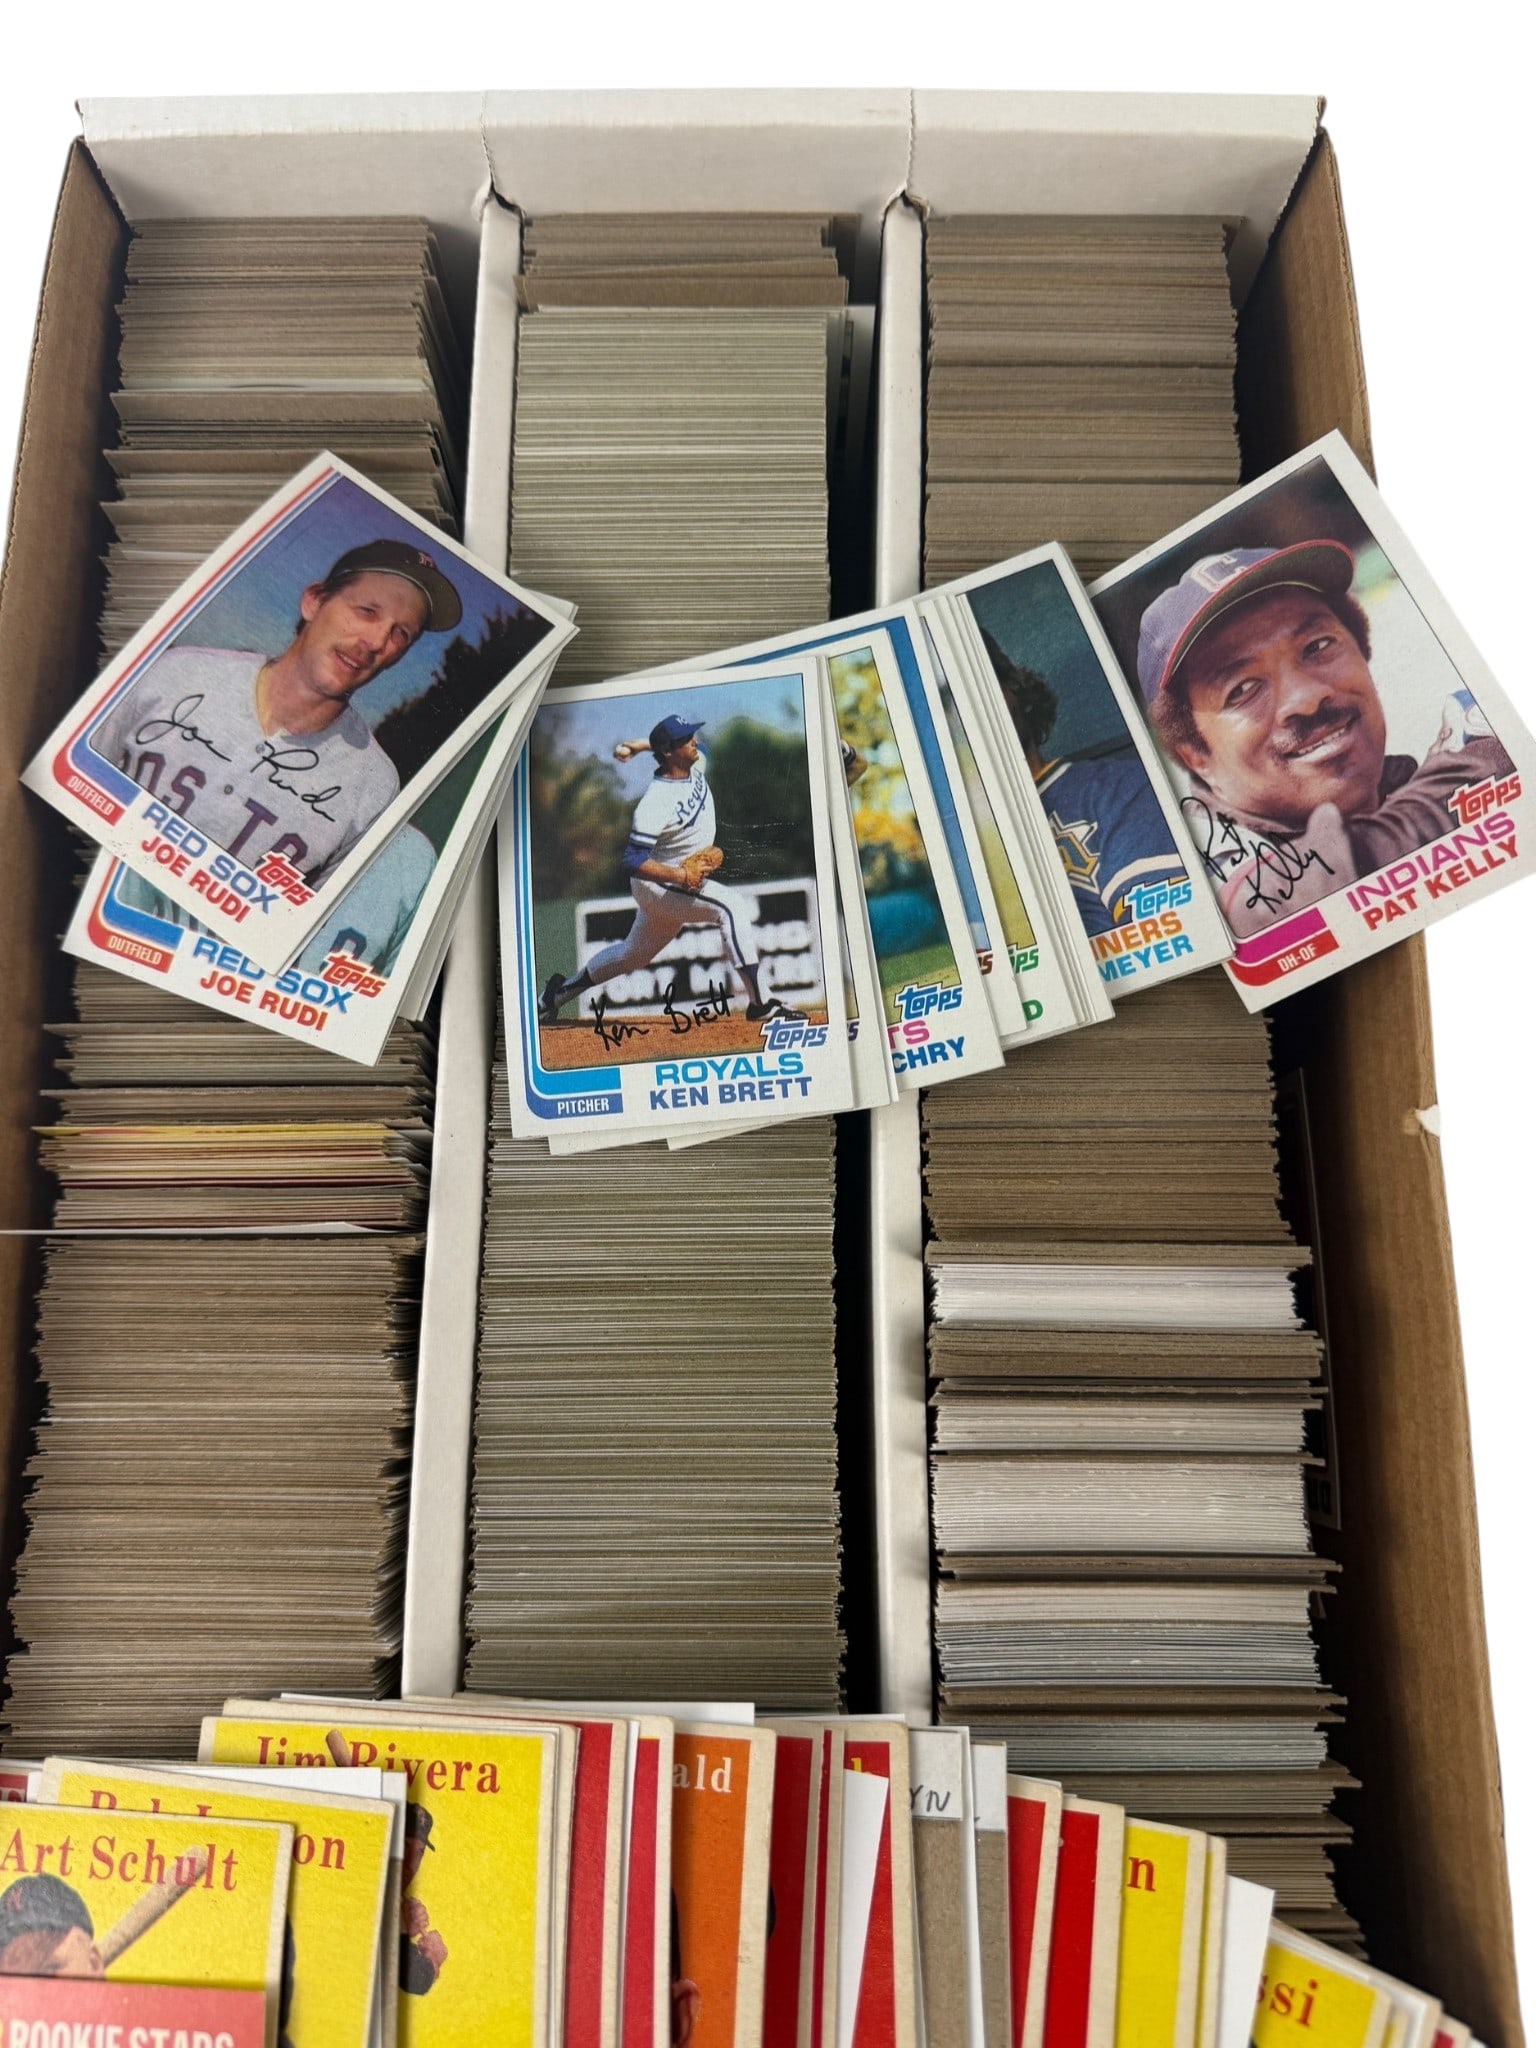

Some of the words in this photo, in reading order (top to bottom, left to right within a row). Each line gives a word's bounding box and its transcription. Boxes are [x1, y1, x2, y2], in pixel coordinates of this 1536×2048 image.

[67, 775, 116, 817] OUTFIELD
[141, 801, 208, 858] RED
[209, 854, 280, 914] SOX
[141, 835, 192, 877] JOE
[189, 869, 251, 923] RUDI
[1346, 811, 1515, 912] INDIANS
[1362, 888, 1418, 931] PAT
[1424, 835, 1518, 899] KELLY
[108, 935, 162, 966] OUTFIELD
[1277, 944, 1318, 972] DH-OF
[200, 970, 256, 1003] JOE
[259, 990, 328, 1031] RUDI
[275, 970, 353, 1014] SOX
[590, 996, 650, 1051] Ken
[663, 978, 735, 1034] Brett
[650, 1085, 709, 1110] KEN
[719, 1076, 812, 1104] BRETT
[655, 1052, 804, 1086] ROYALS
[557, 1098, 610, 1115] PITCHER
[0, 1827, 74, 1876] Art
[89, 1835, 239, 1891] Schult
